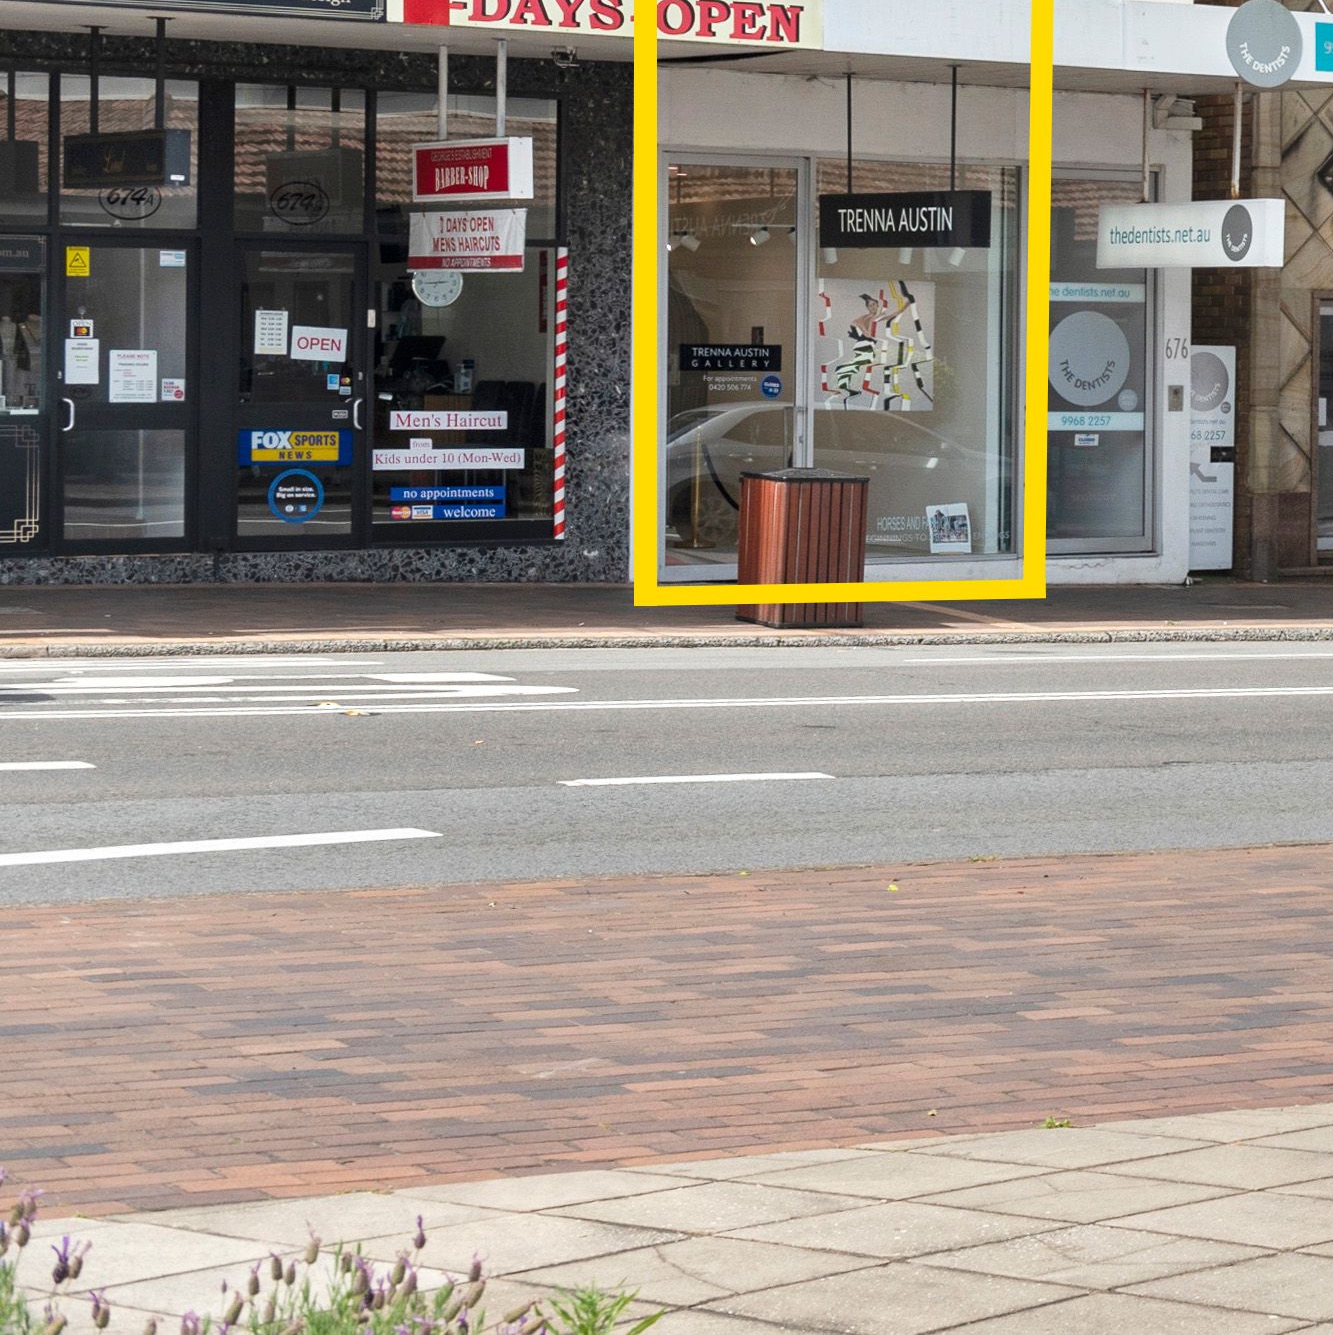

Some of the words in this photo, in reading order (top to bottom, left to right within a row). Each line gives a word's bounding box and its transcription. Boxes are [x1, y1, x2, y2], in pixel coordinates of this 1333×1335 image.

[1239, 42, 1253, 65] THE
[1252, 45, 1290, 74] DENTISTS
[435, 165, 489, 192] BARBER-SHOP
[446, 217, 467, 233] DAYS
[470, 216, 494, 232] OPEN
[838, 208, 895, 233] TRENNA
[898, 207, 953, 232] AUSTIN
[1110, 225, 1211, 245] thedentists.net.au
[432, 237, 457, 252] MENS
[459, 235, 500, 251] HAIRCUTS
[297, 336, 342, 352] OPEN
[692, 347, 732, 357] TRENNA
[734, 347, 770, 357] AUSTIN
[1165, 338, 1188, 359] 676
[691, 360, 770, 368] GALLERY
[1059, 359, 1075, 383] THE
[1074, 360, 1116, 391] DENTISTS
[396, 413, 441, 428] Men's
[446, 413, 502, 428] Haircut
[1062, 416, 1085, 426] 9968
[1088, 416, 1111, 426] 2257
[251, 431, 293, 449] FOX
[294, 435, 337, 446] SPORTS
[412, 440, 430, 448] from
[279, 451, 312, 460] NEWS
[375, 453, 401, 465] Kids
[405, 452, 438, 464] under
[442, 453, 454, 464] 10
[458, 451, 521, 465] (Mon-Wed)
[403, 490, 418, 498] no
[420, 487, 494, 500] appointments
[443, 505, 496, 517] welcome
